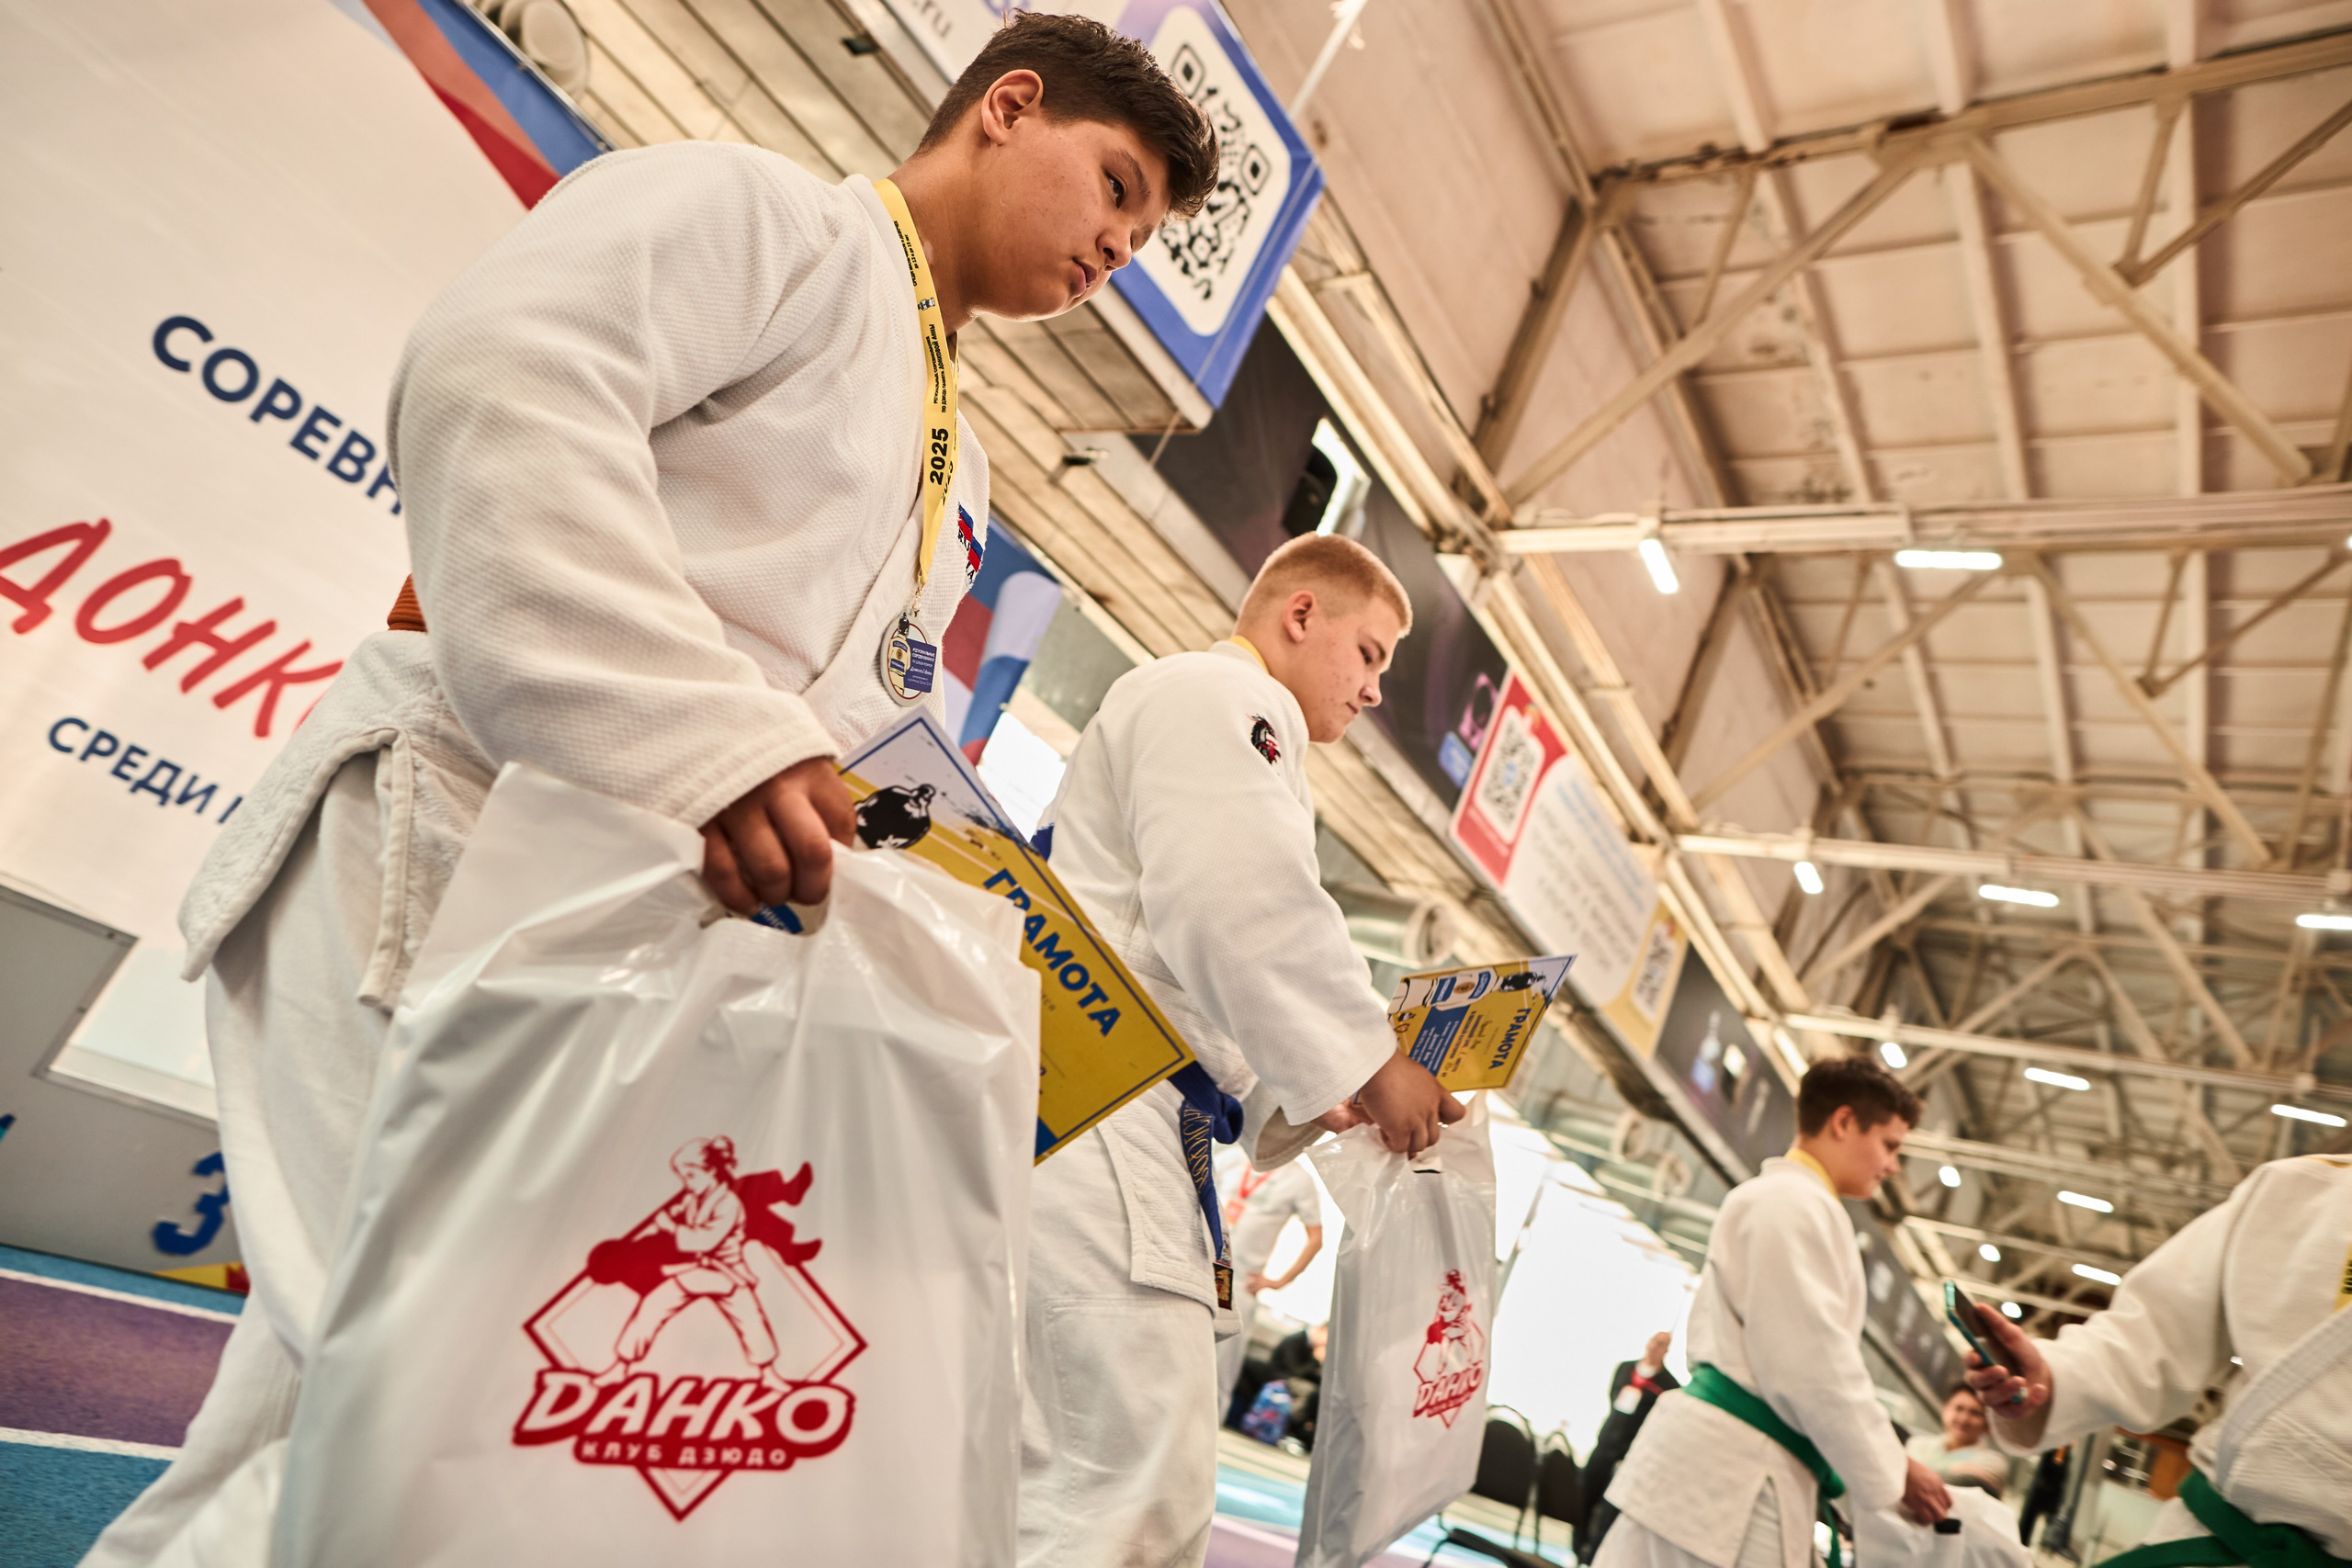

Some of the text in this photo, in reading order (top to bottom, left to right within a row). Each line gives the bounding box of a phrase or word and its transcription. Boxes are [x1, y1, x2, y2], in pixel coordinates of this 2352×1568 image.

[930, 428, 949, 486] 2025
[0, 517, 346, 739] ДОНК
[47, 716, 220, 818] СРЕДИ
[983, 868, 1122, 1036] ГРАМОТА
[1487, 1008, 1532, 1070] ГРАМОТА
[152, 1151, 230, 1256] 3
[582, 1441, 787, 1468] КЛУБ ДЗЮДО
